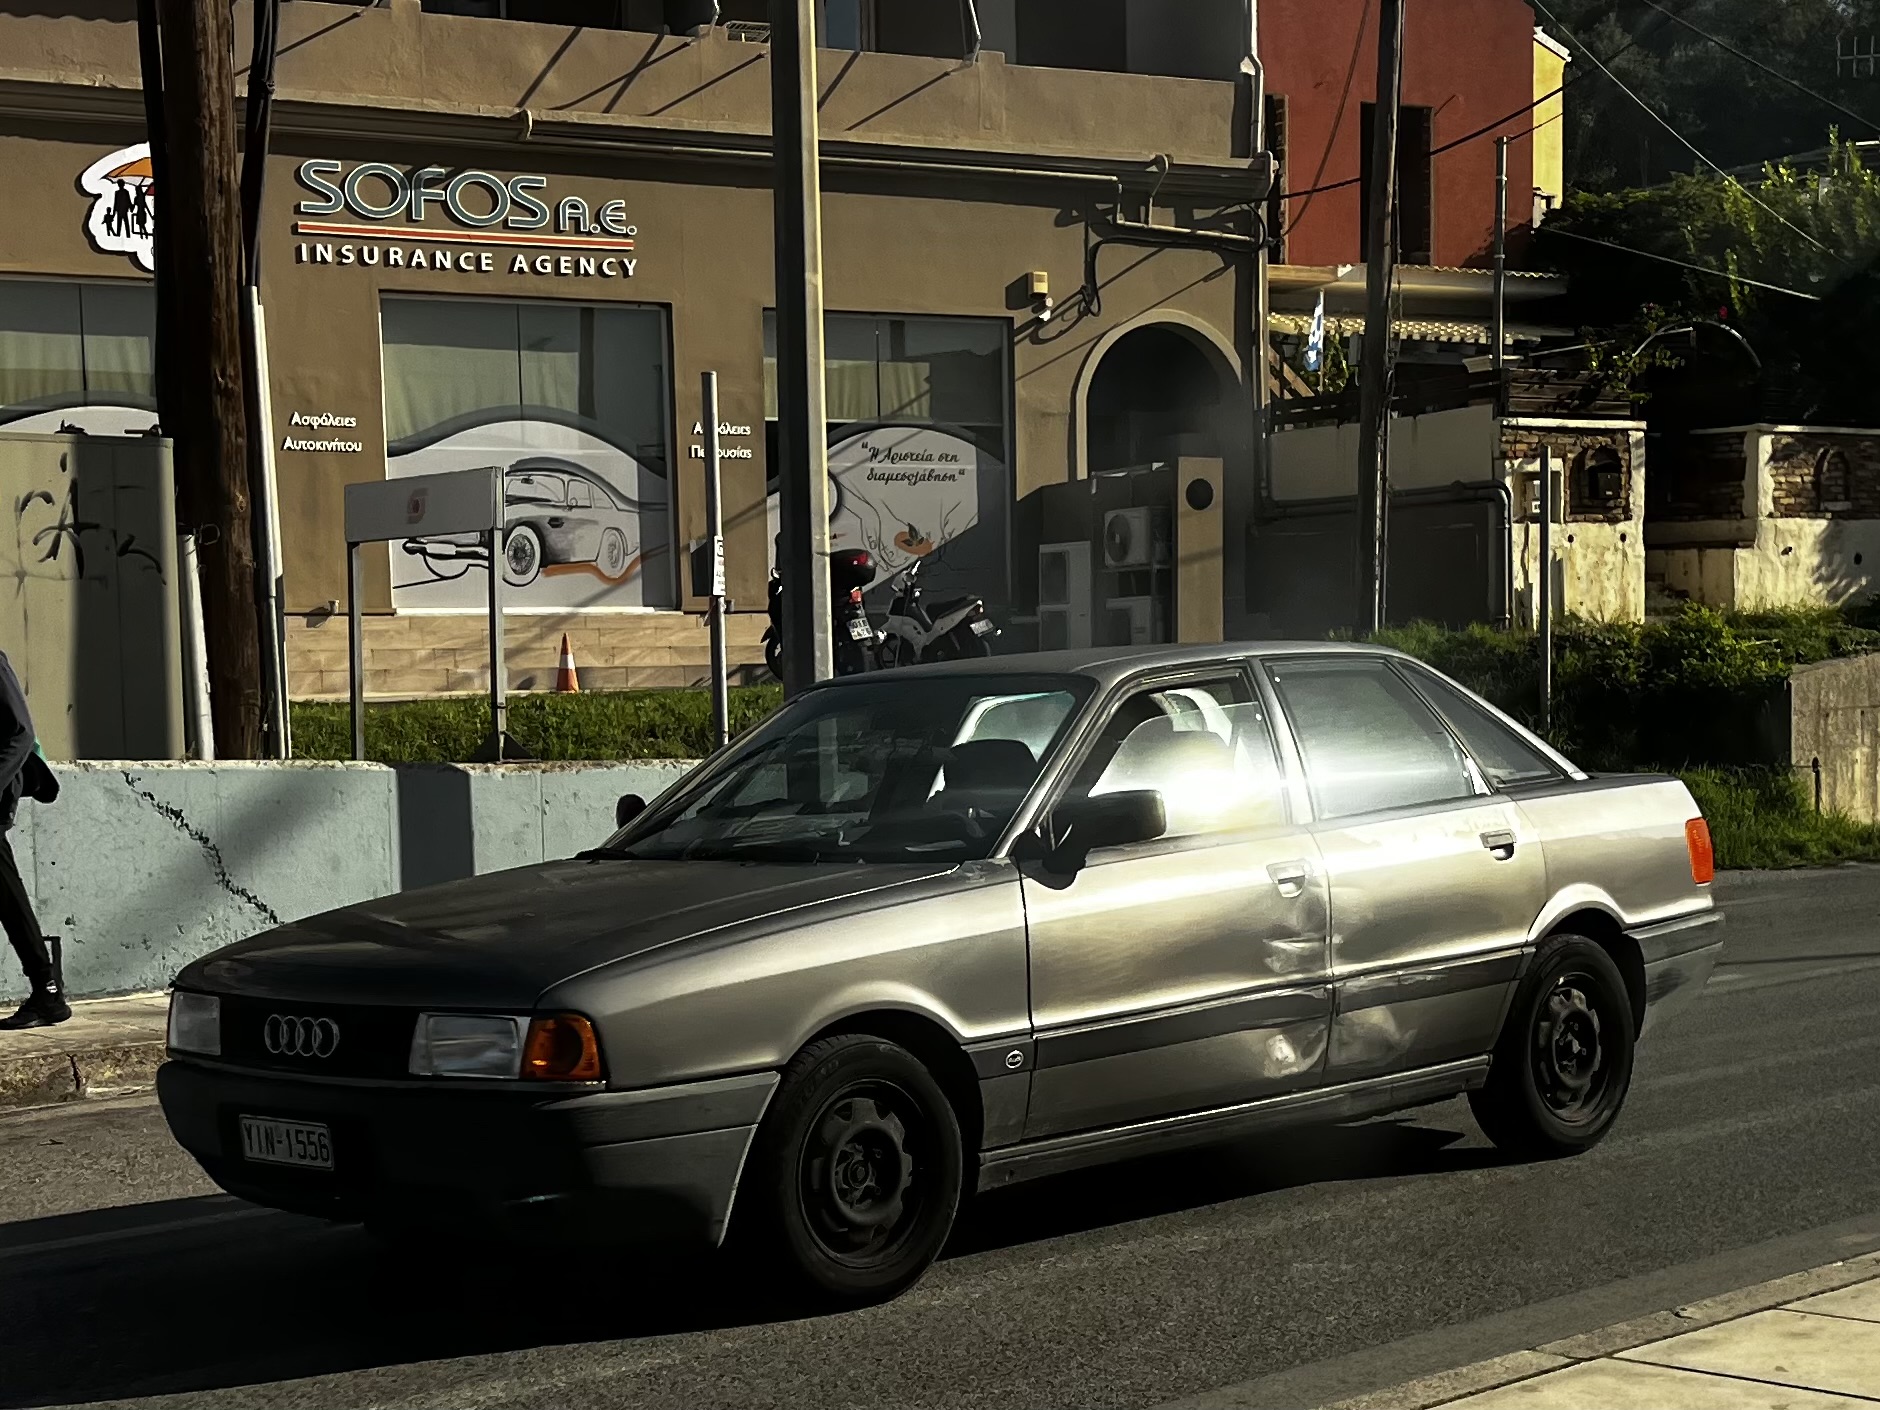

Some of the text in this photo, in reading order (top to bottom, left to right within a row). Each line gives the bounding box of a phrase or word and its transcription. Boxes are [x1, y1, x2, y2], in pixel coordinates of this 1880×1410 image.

[300, 159, 550, 228] SOFOS
[301, 242, 638, 276] INSURANCE AGENCY
[291, 411, 356, 429] Ασφάλειες
[693, 421, 751, 435] Αάλειες
[283, 436, 362, 452] Αυτοκινήτου
[878, 446, 934, 465] Αριστεία
[938, 452, 960, 462] στη
